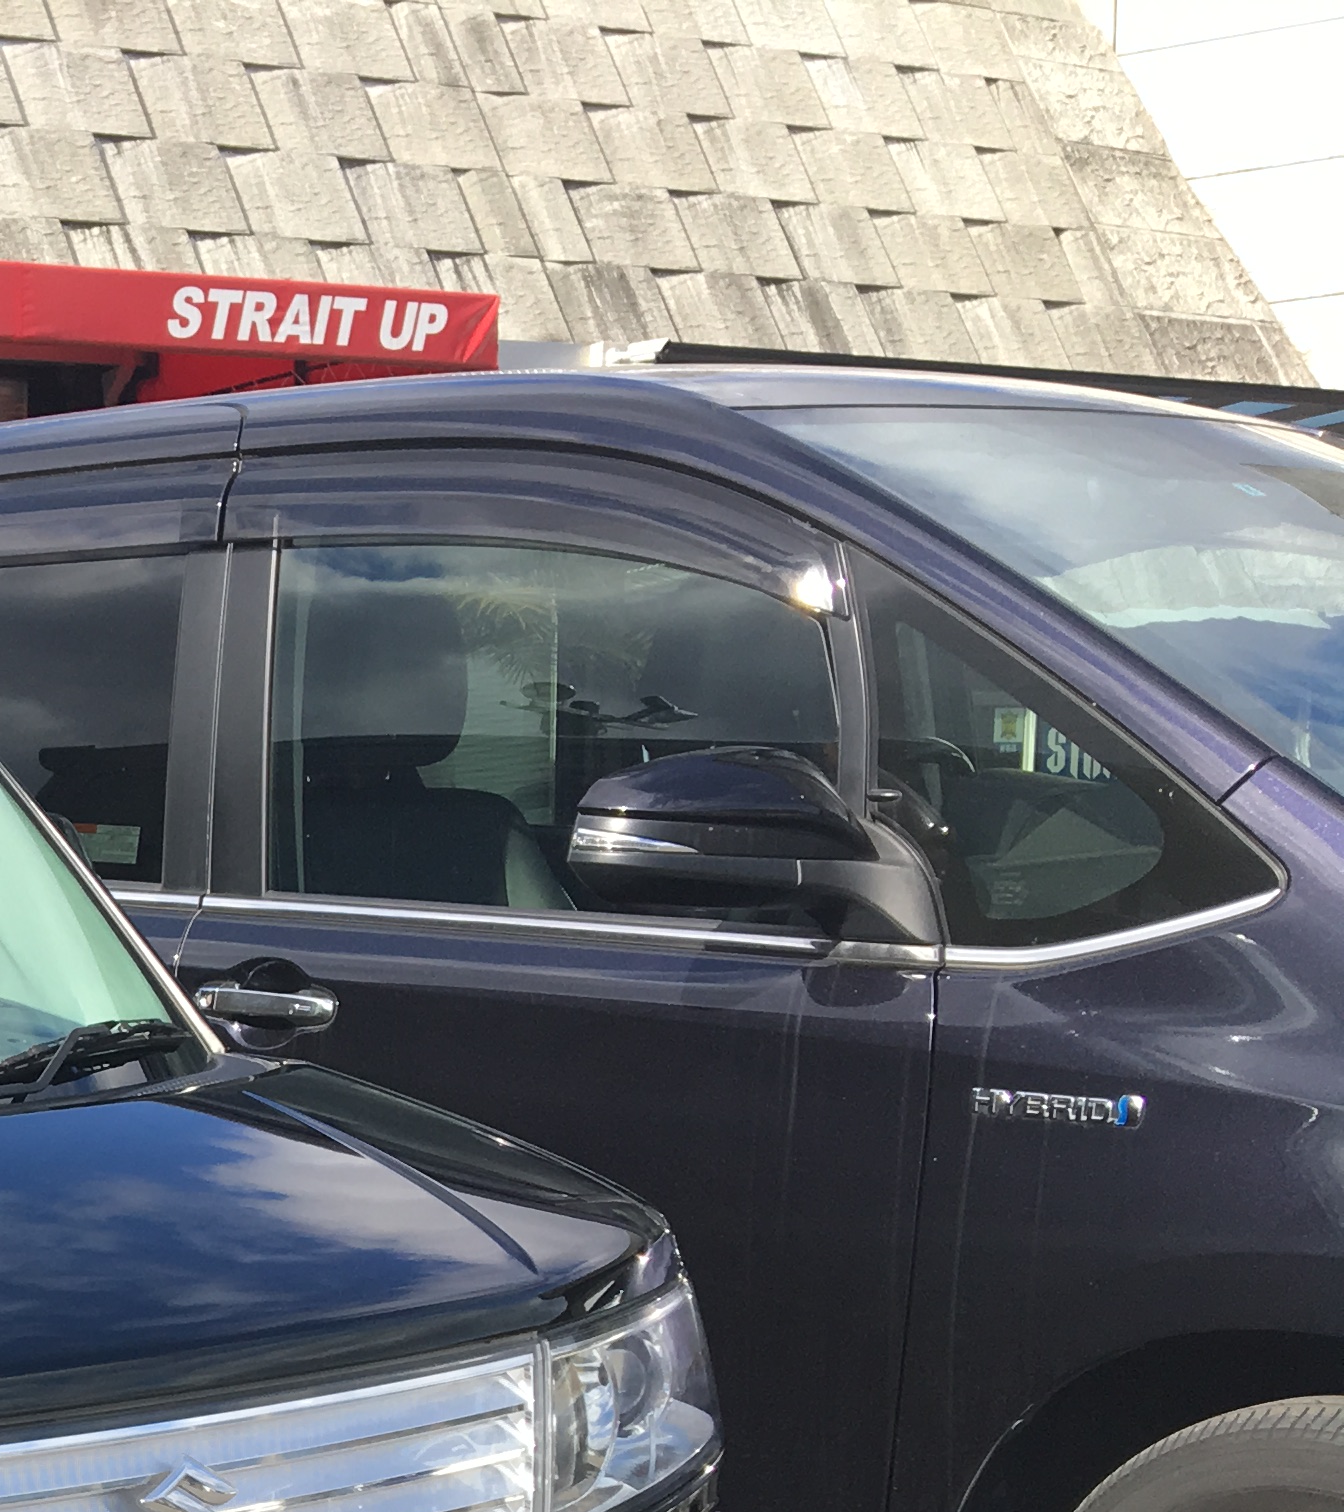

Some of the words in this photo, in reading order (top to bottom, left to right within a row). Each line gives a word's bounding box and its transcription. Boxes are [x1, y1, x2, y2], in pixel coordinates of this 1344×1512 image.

[167, 286, 368, 346] STRAIT
[379, 299, 448, 352] UP
[971, 1086, 1115, 1124] HYBRID
